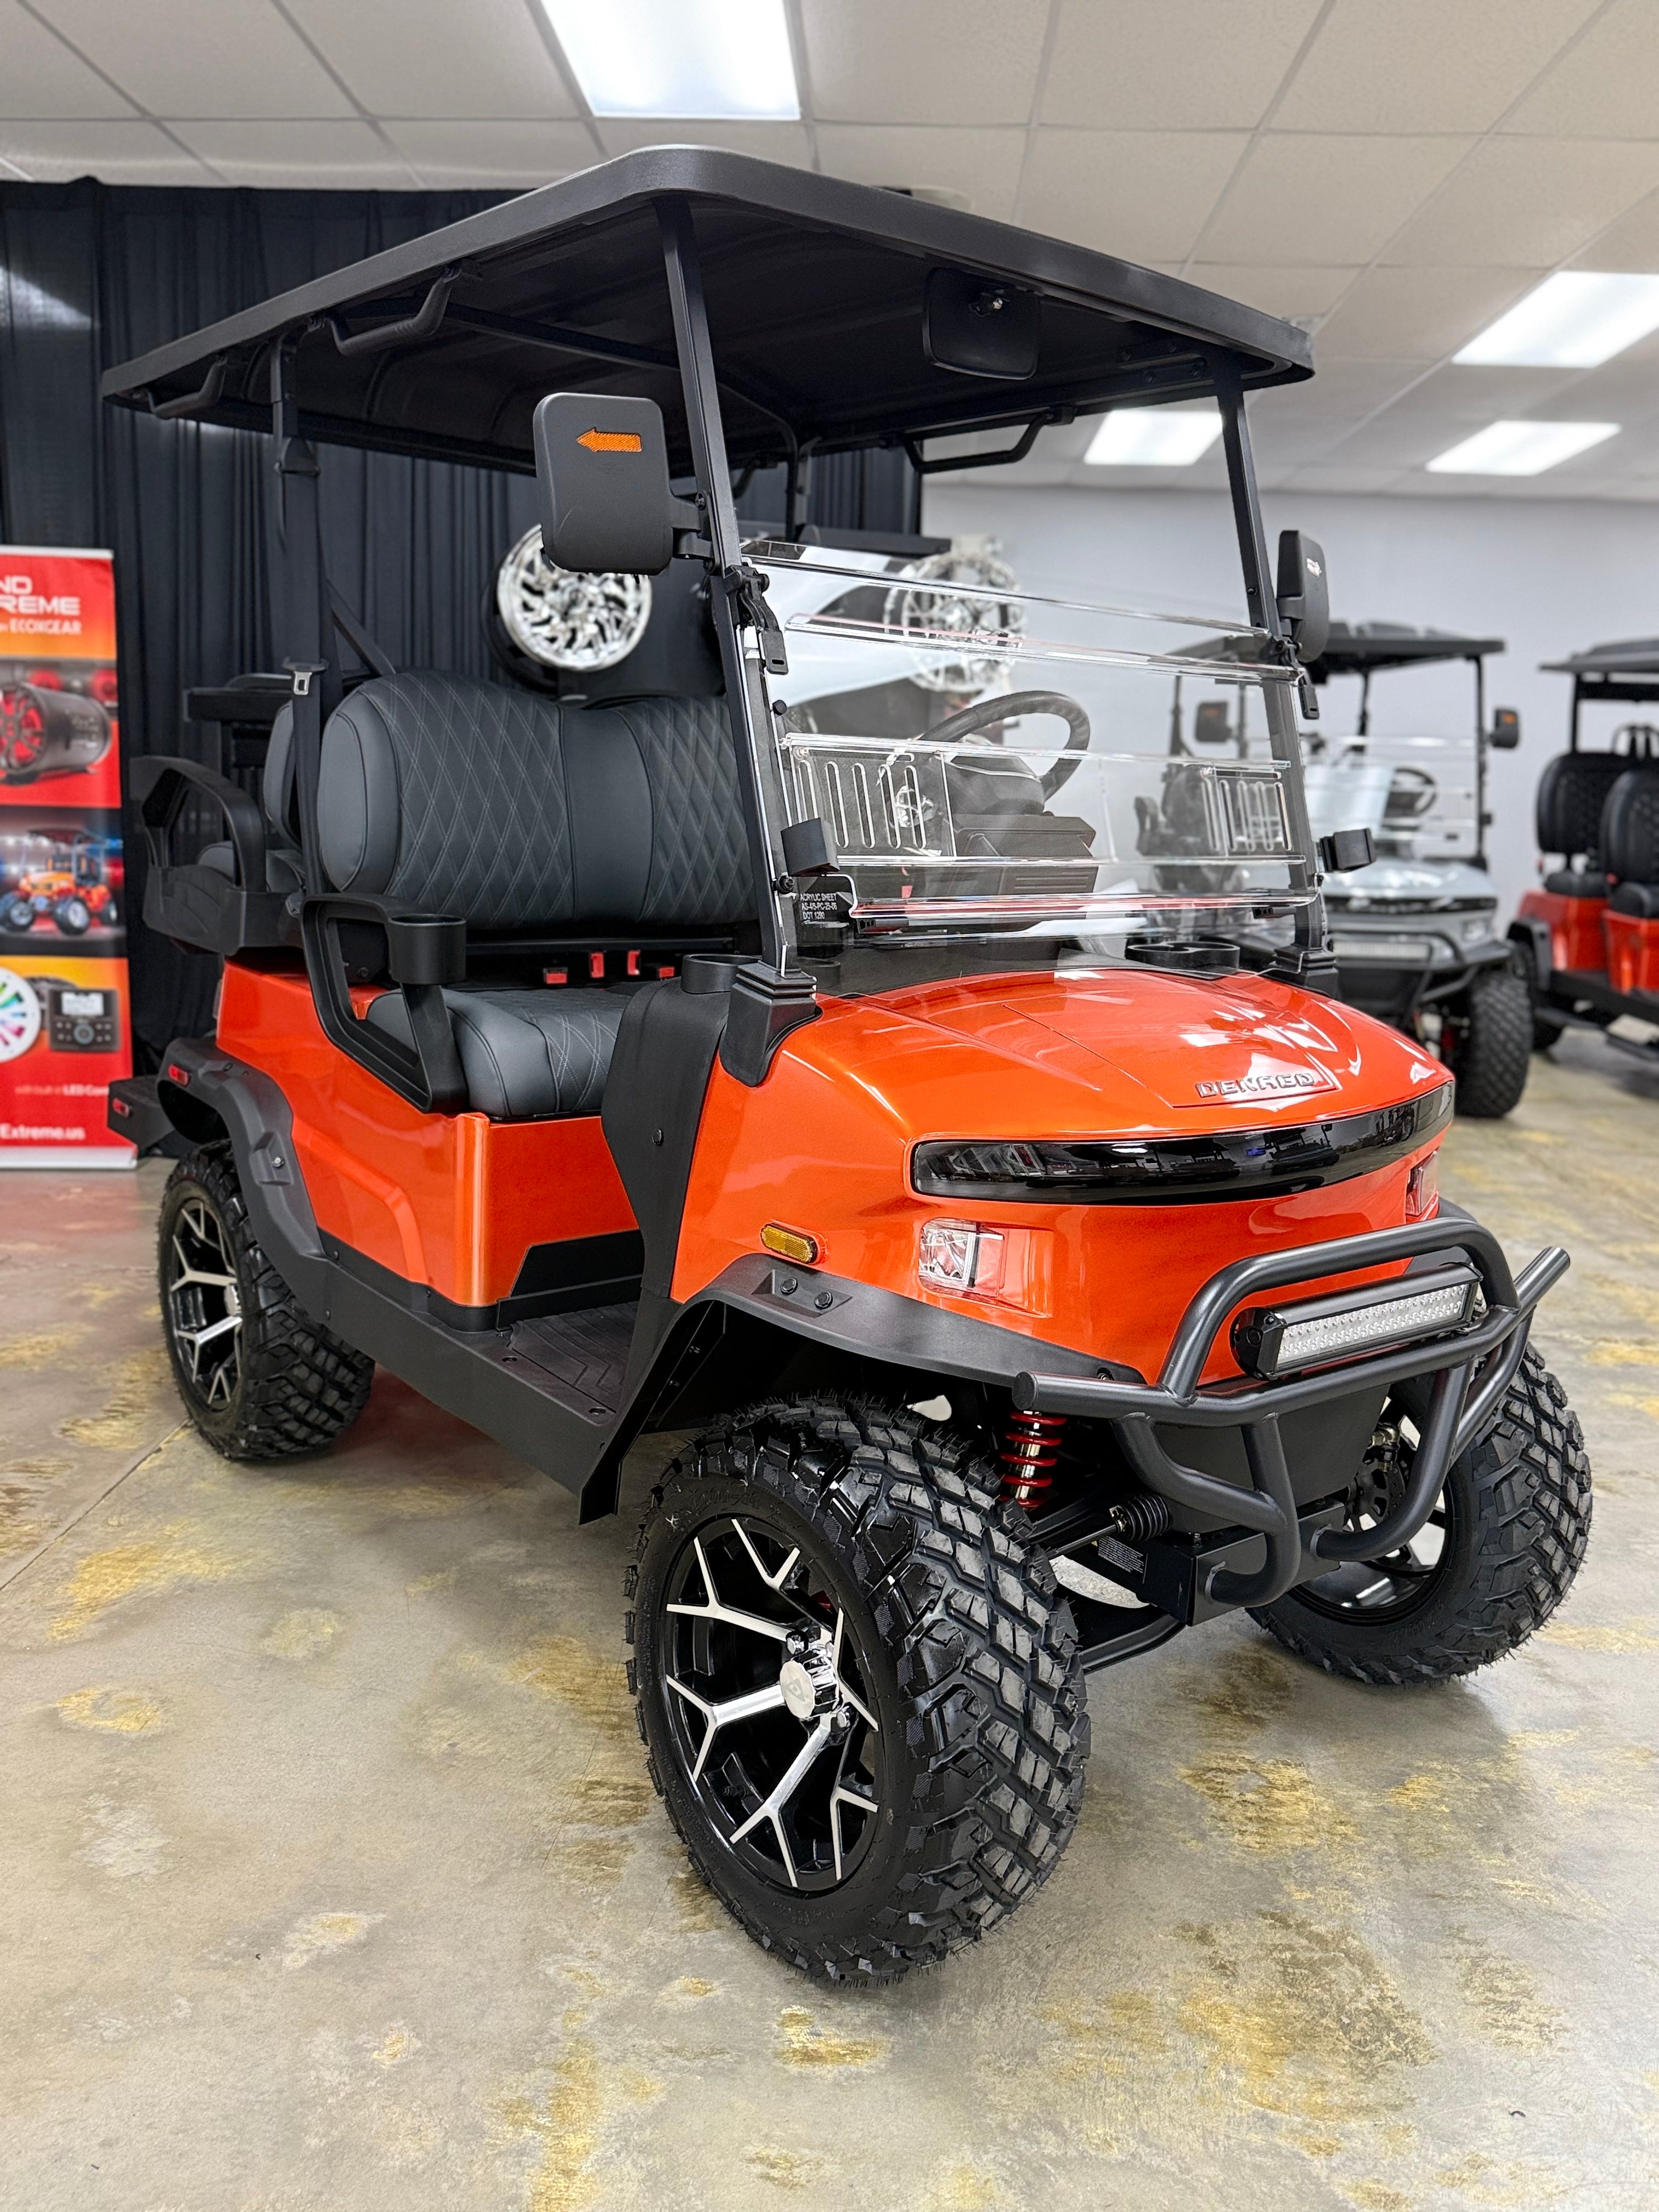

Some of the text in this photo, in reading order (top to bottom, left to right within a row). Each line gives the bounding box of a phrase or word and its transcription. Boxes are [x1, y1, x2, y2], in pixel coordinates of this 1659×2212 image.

[800, 893, 837, 901] ACRYLIC SHEET
[803, 911, 813, 919] DOT
